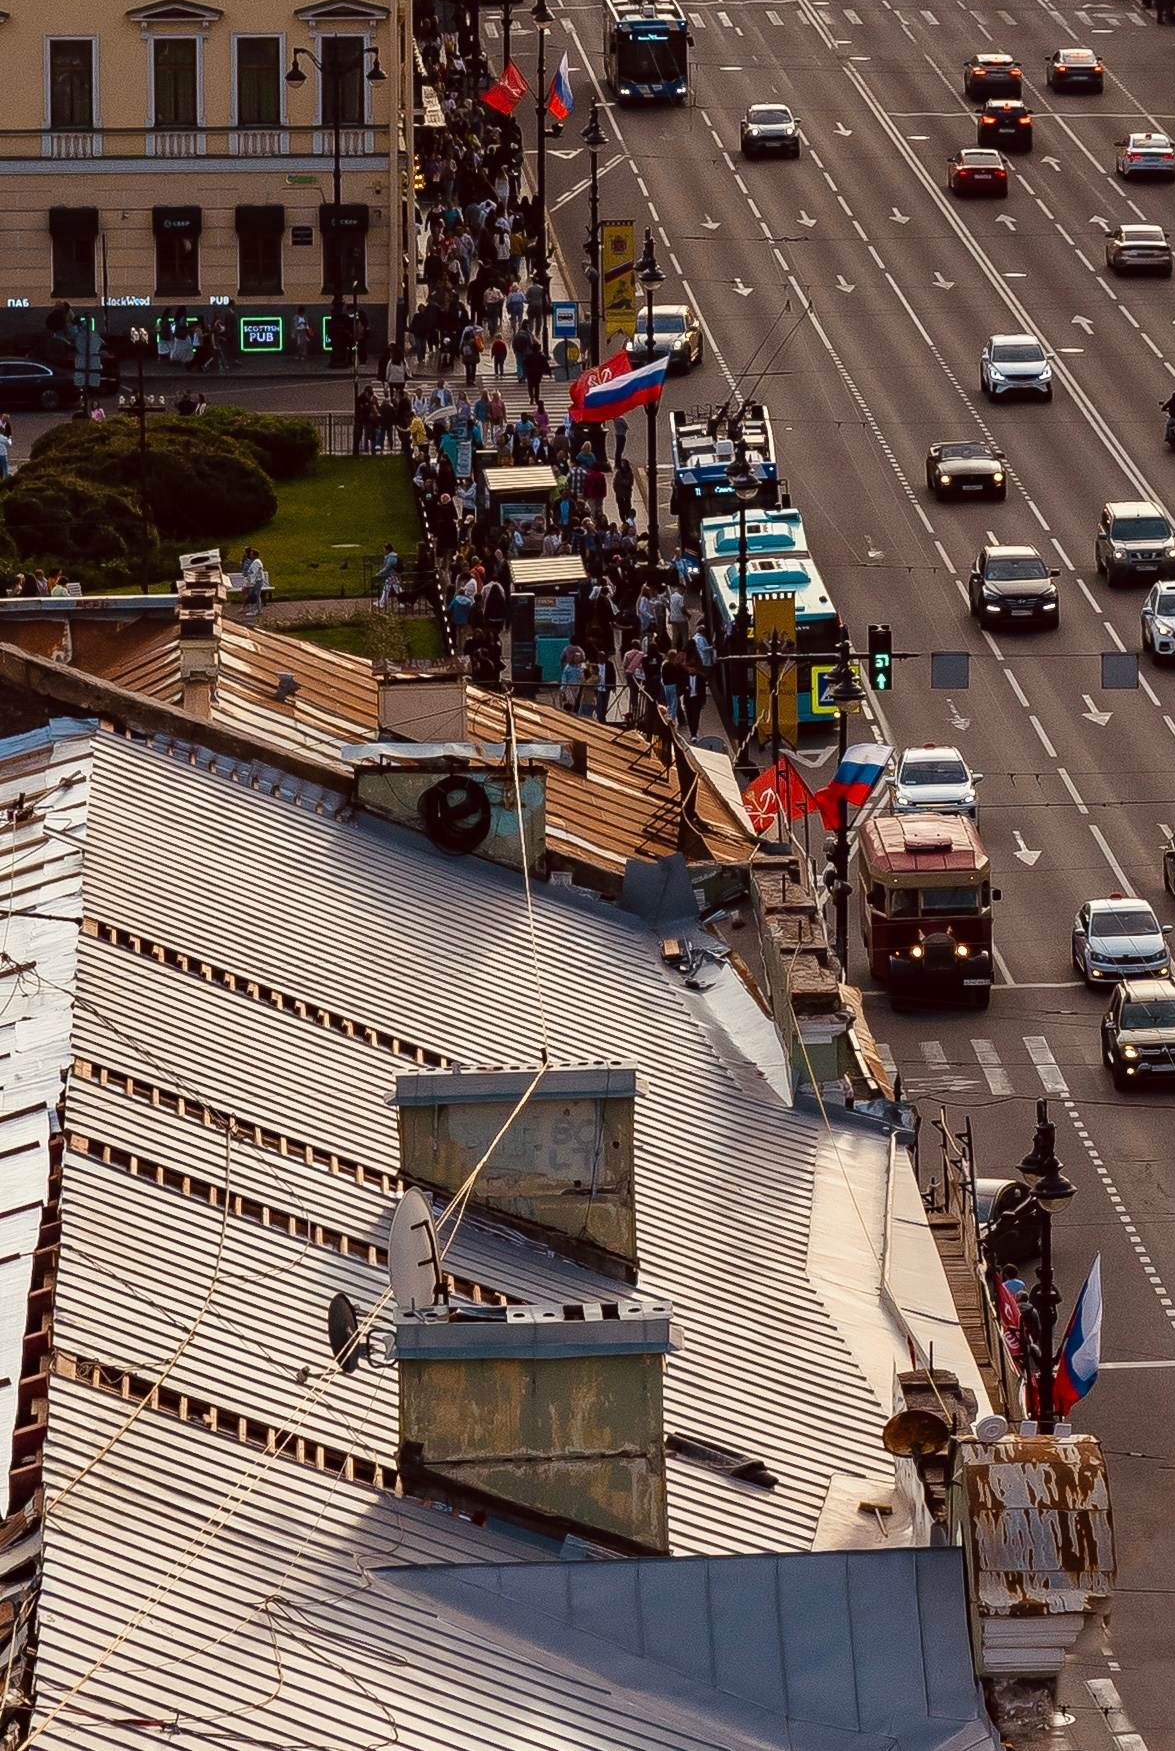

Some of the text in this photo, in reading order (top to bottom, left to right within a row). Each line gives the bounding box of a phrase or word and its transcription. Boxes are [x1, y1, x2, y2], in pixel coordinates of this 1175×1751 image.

[7, 299, 30, 308] ПАБ
[209, 296, 230, 305] PUB
[249, 333, 275, 342] PUB
